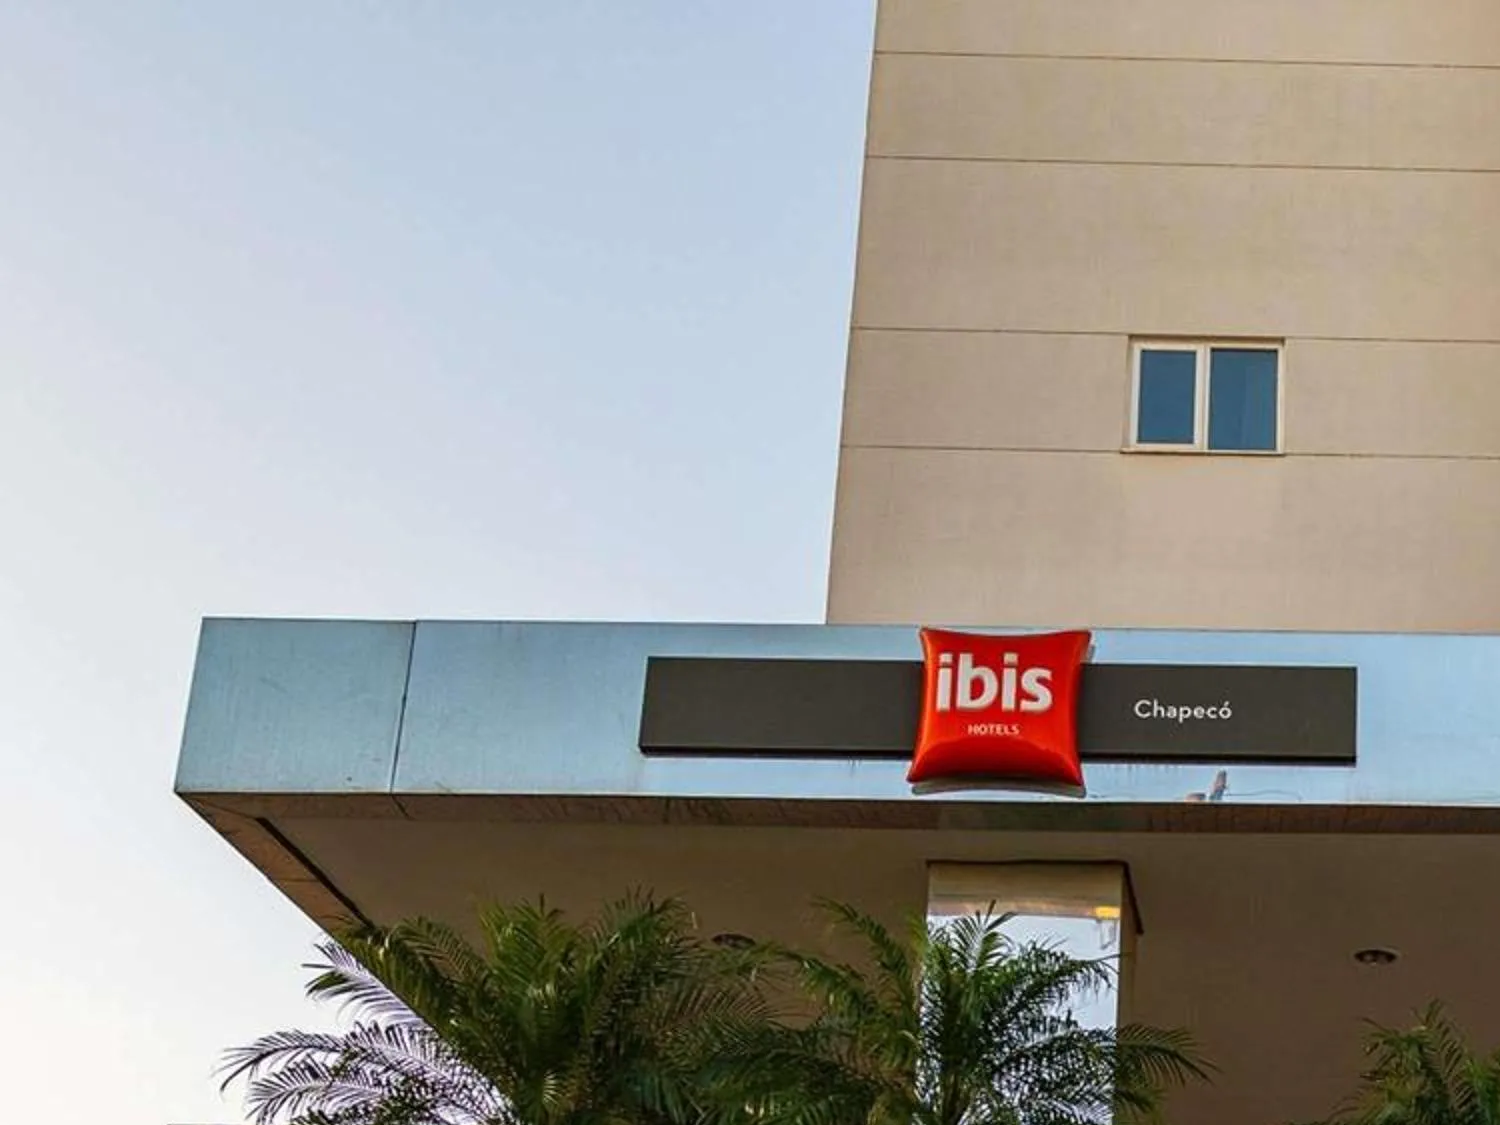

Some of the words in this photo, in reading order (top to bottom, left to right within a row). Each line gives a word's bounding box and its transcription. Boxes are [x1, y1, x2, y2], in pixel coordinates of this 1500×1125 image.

[936, 652, 1053, 712] ibis
[1134, 698, 1232, 723] Chapecó
[967, 723, 1020, 735] HOTELS
